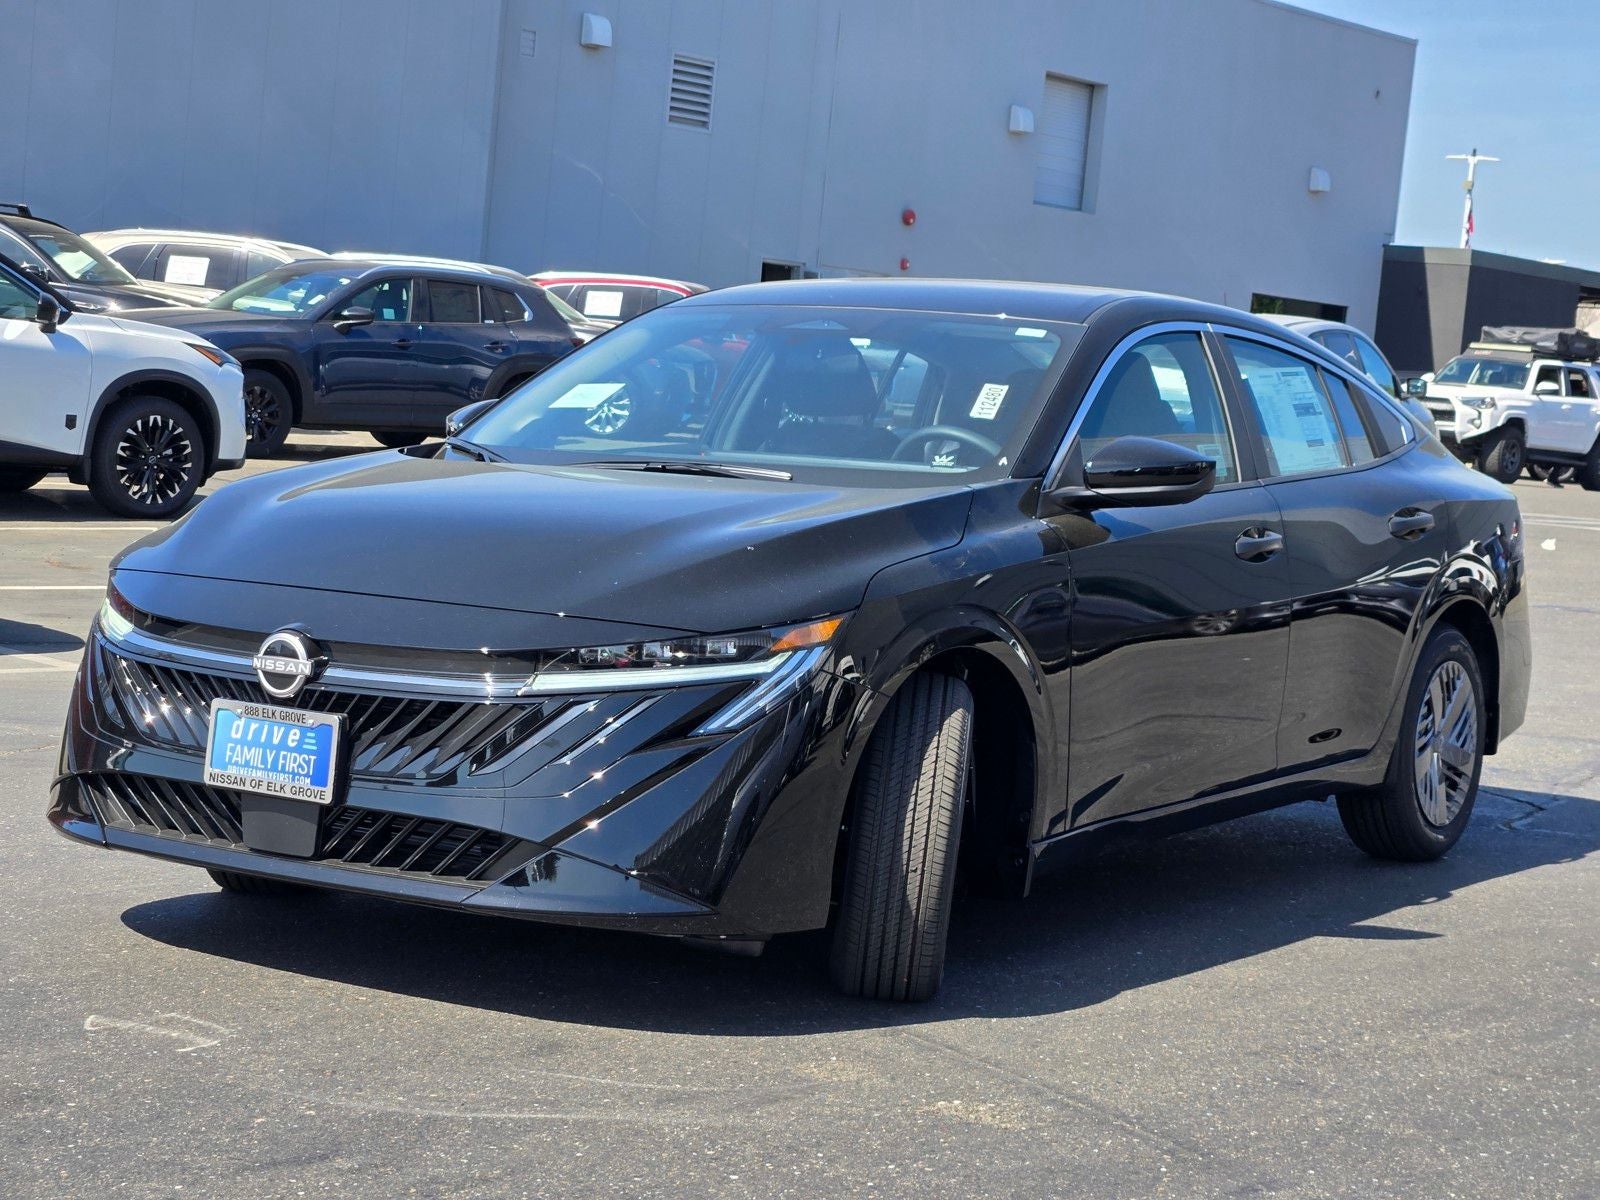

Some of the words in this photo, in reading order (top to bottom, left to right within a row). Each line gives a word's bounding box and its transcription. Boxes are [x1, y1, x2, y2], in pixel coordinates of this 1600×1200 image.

[253, 657, 310, 675] NISSAN
[244, 705, 260, 717] 888
[262, 708, 277, 720] ELK
[279, 710, 307, 724] GROVE
[231, 718, 300, 747] drive
[226, 743, 276, 770] FAMILY
[278, 751, 316, 775] FIRST
[209, 772, 246, 787] NISSAN
[249, 778, 264, 790] OF
[266, 781, 287, 794] ELK
[290, 785, 326, 800] GROVE
